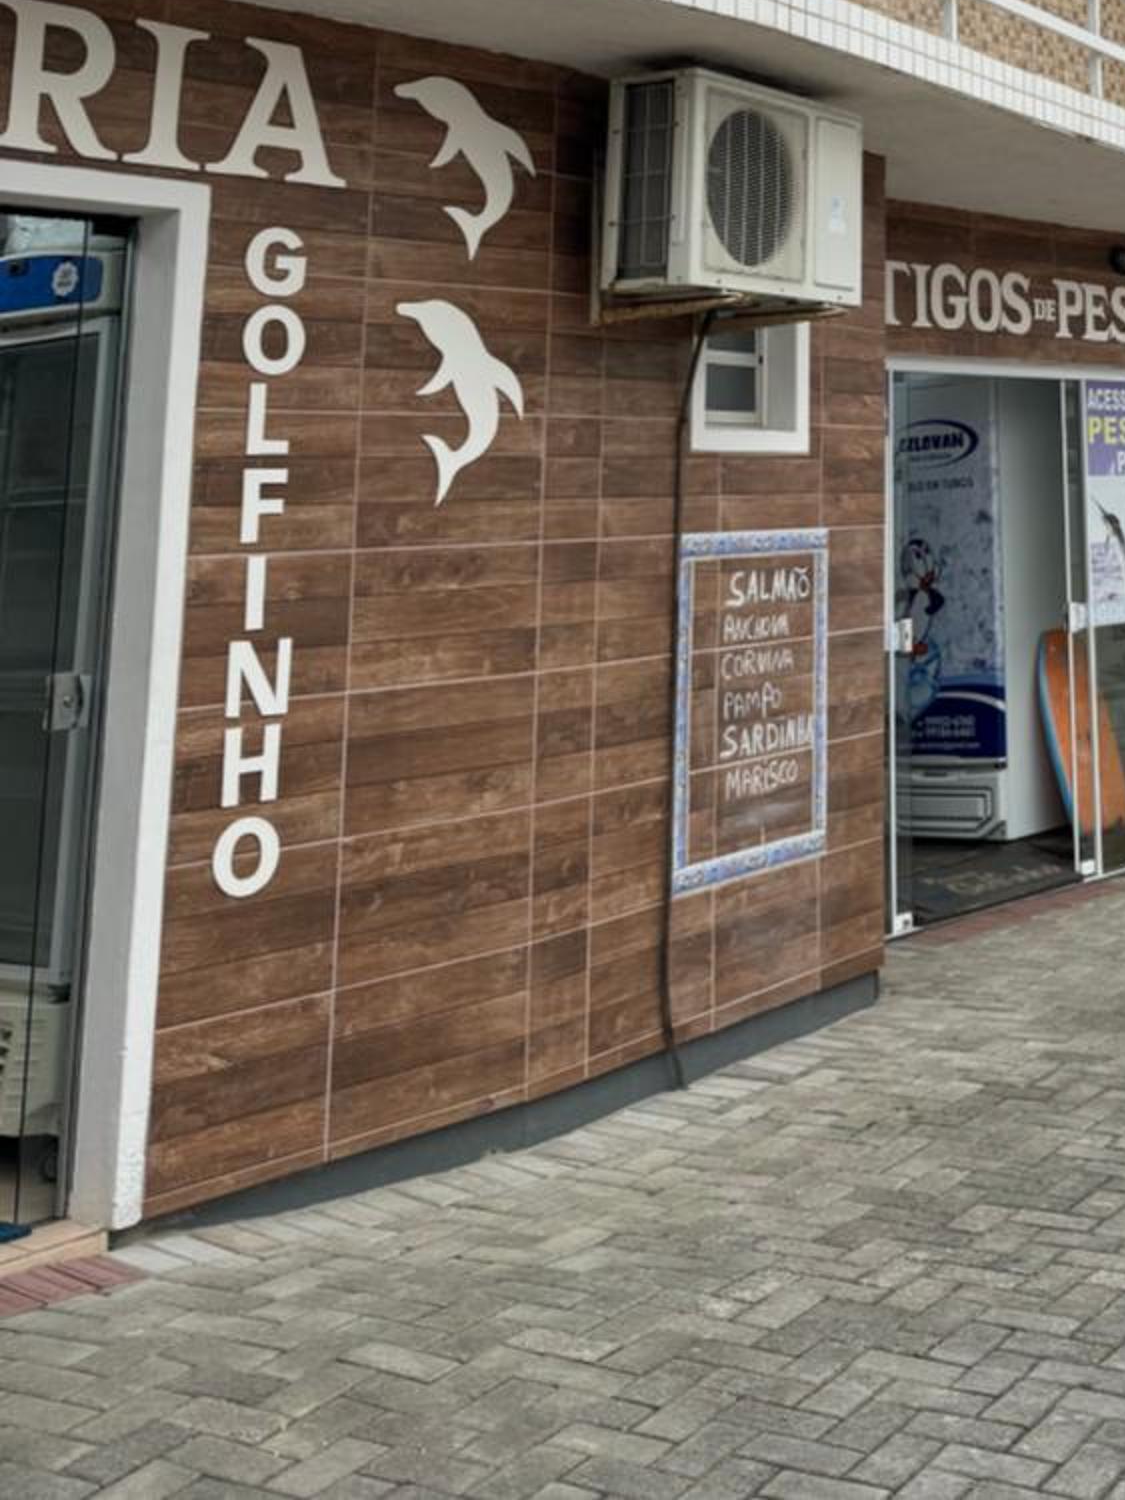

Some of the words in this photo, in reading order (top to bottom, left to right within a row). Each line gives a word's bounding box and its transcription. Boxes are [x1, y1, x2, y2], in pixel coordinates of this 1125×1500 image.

[1034, 296, 1056, 323] DE
[211, 227, 307, 898] GOLFINHO
[721, 648, 794, 680] CORVINA
[723, 681, 783, 720] PAMPO
